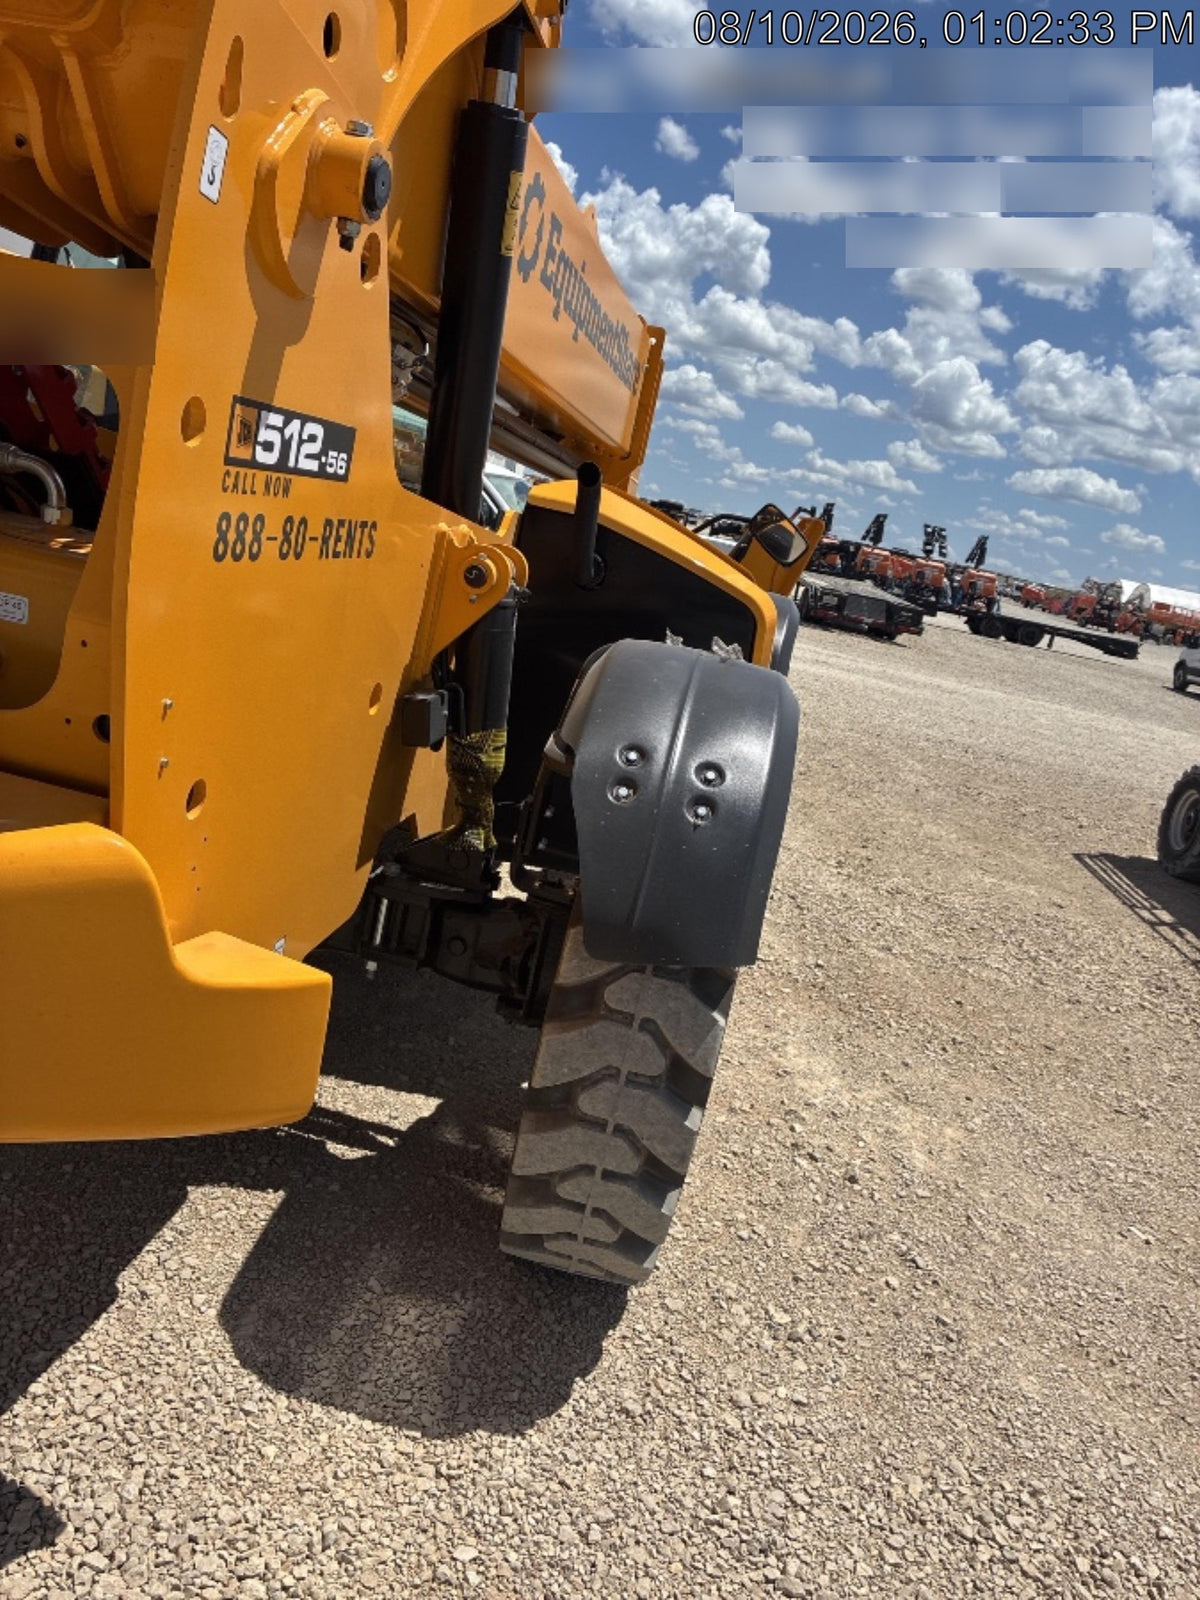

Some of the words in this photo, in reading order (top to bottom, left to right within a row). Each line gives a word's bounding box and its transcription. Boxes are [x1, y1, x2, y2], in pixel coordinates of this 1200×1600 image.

[222, 470, 257, 495] CALL
[263, 476, 292, 498] NOW
[213, 511, 377, 562] 888-80-RENTS
